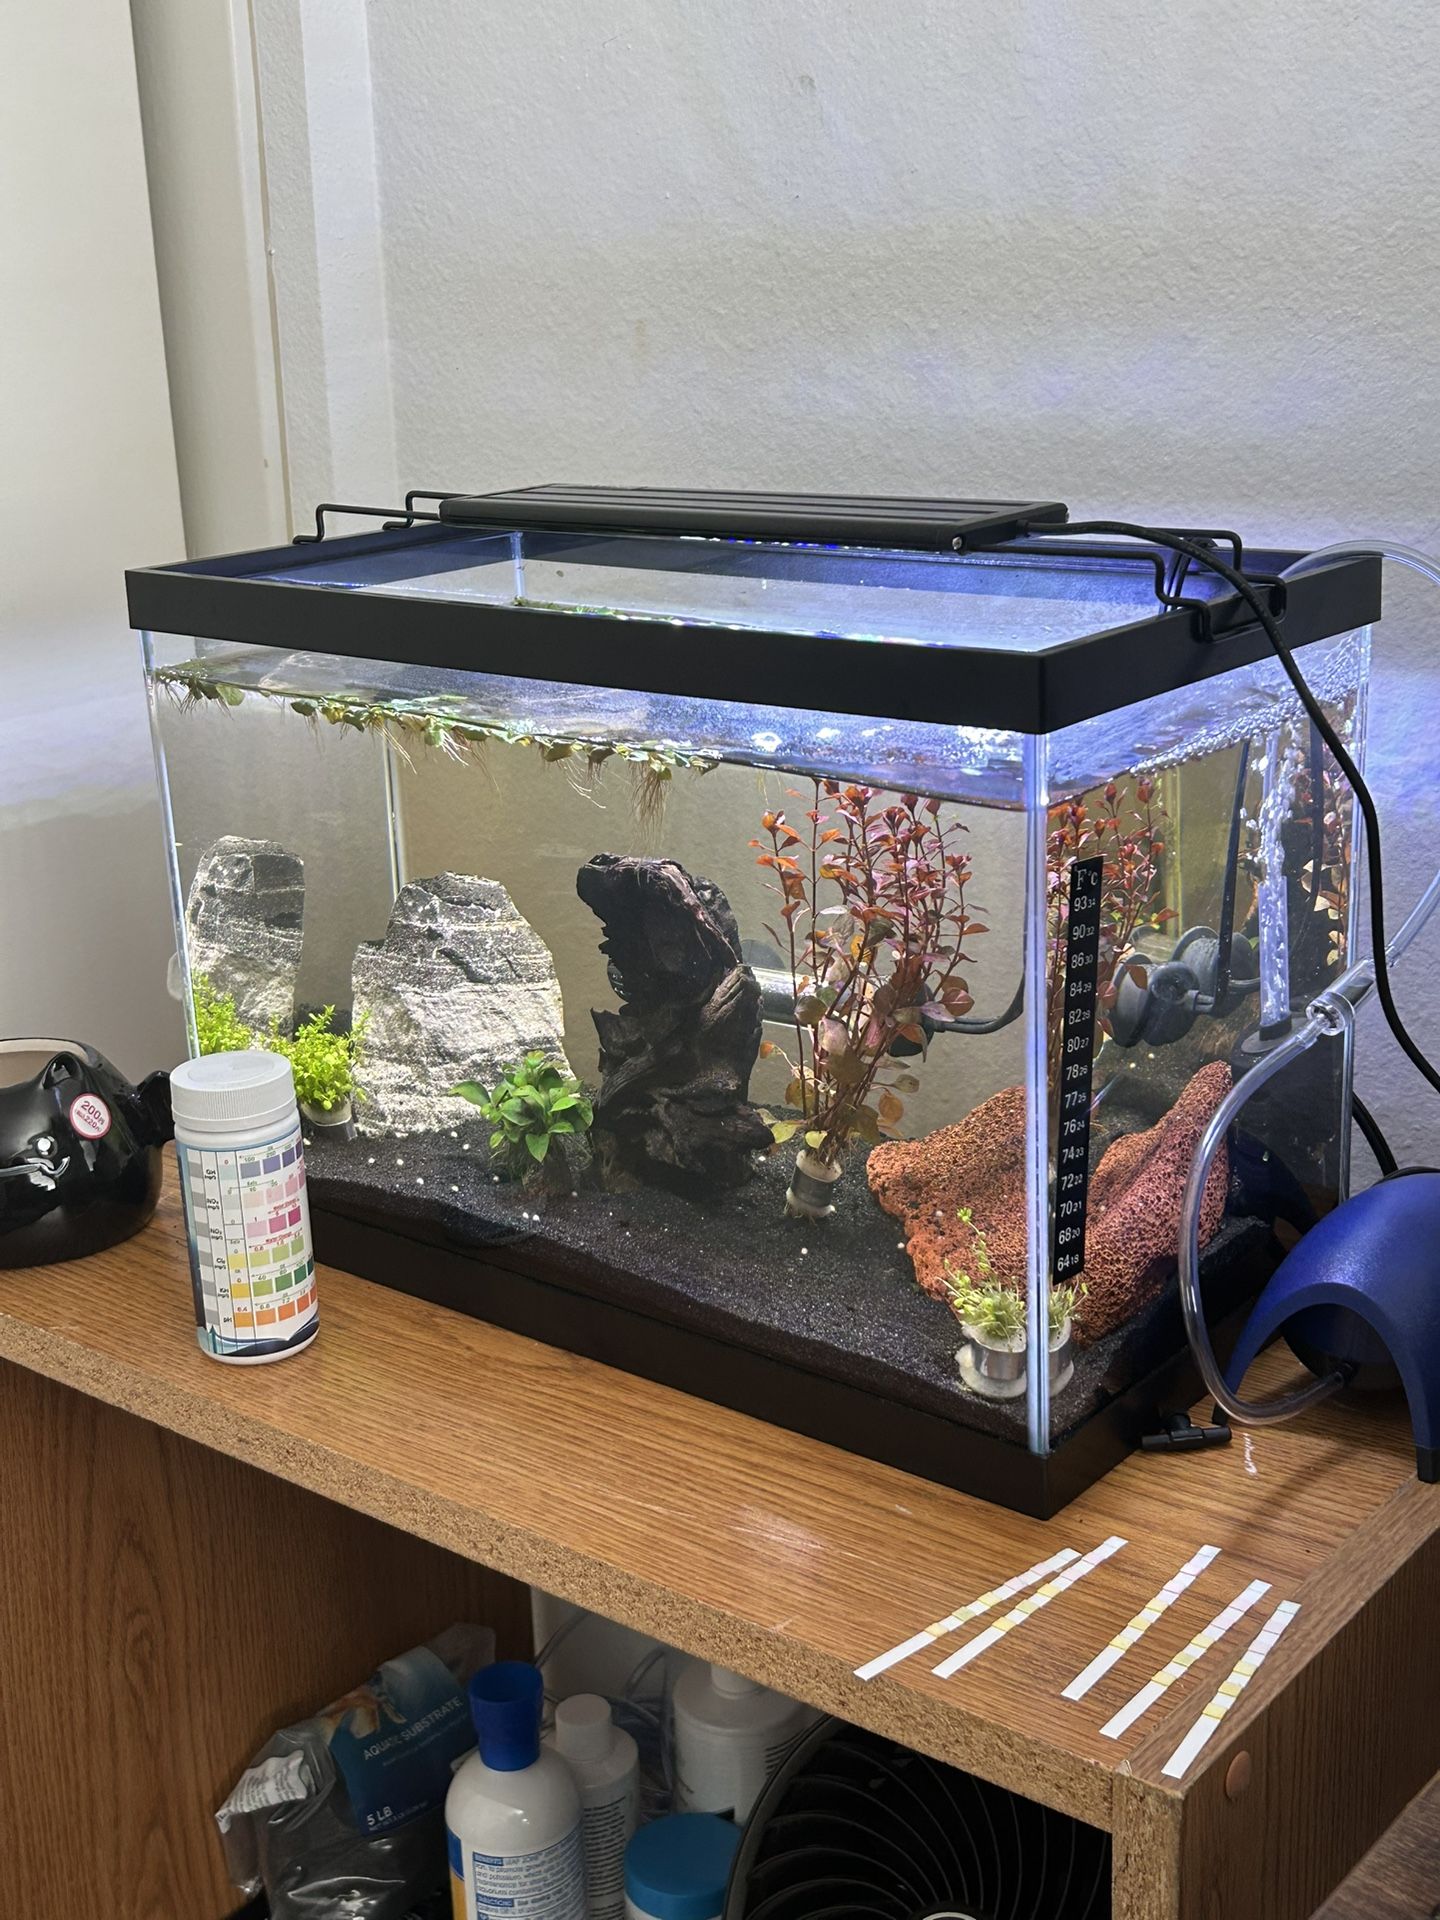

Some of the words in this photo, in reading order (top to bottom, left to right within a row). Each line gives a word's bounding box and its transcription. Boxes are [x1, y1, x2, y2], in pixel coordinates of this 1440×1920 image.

[1073, 896, 1087, 912] 93
[1072, 923, 1086, 940] 90
[1071, 952, 1084, 969] 86
[1069, 980, 1083, 997] 84
[1068, 1008, 1082, 1025] 82
[1067, 1036, 1080, 1053] 80
[1065, 1064, 1079, 1081] 78
[1064, 1091, 1078, 1109] 77
[1063, 1118, 1077, 1136] 76
[1062, 1146, 1075, 1164] 74
[1061, 1173, 1074, 1191] 72
[1060, 1201, 1073, 1218] 70
[1058, 1227, 1072, 1245] 68
[1057, 1254, 1070, 1272] 64
[400, 1696, 464, 1740] SUBSTRATE
[367, 1813, 376, 1826] 5
[376, 1806, 394, 1821] LB
